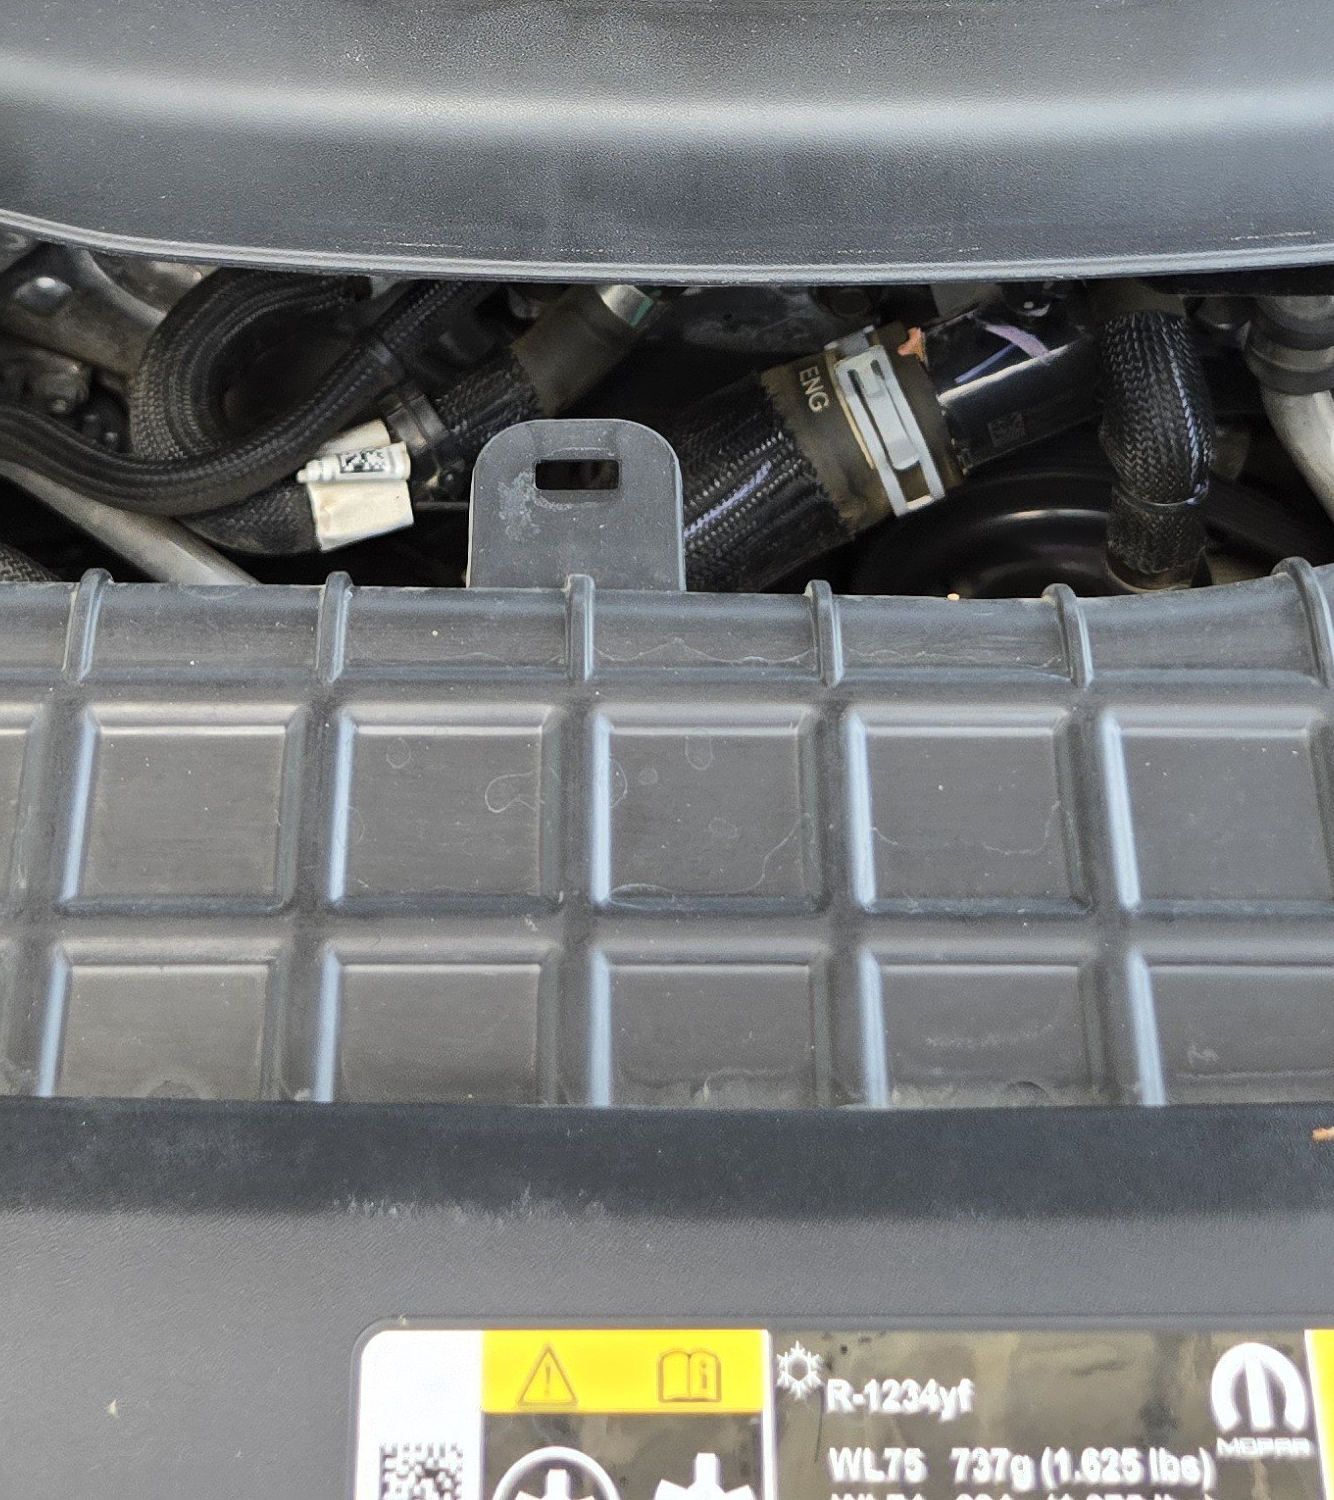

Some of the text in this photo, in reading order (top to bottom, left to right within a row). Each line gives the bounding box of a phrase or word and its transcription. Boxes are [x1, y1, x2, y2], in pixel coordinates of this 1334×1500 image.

[798, 365, 830, 413] ENG
[826, 1378, 975, 1423] R-1234yf
[828, 1446, 1216, 1493] WL75 737g (1.625 lbs)
[1216, 1436, 1314, 1459] MOPAR
